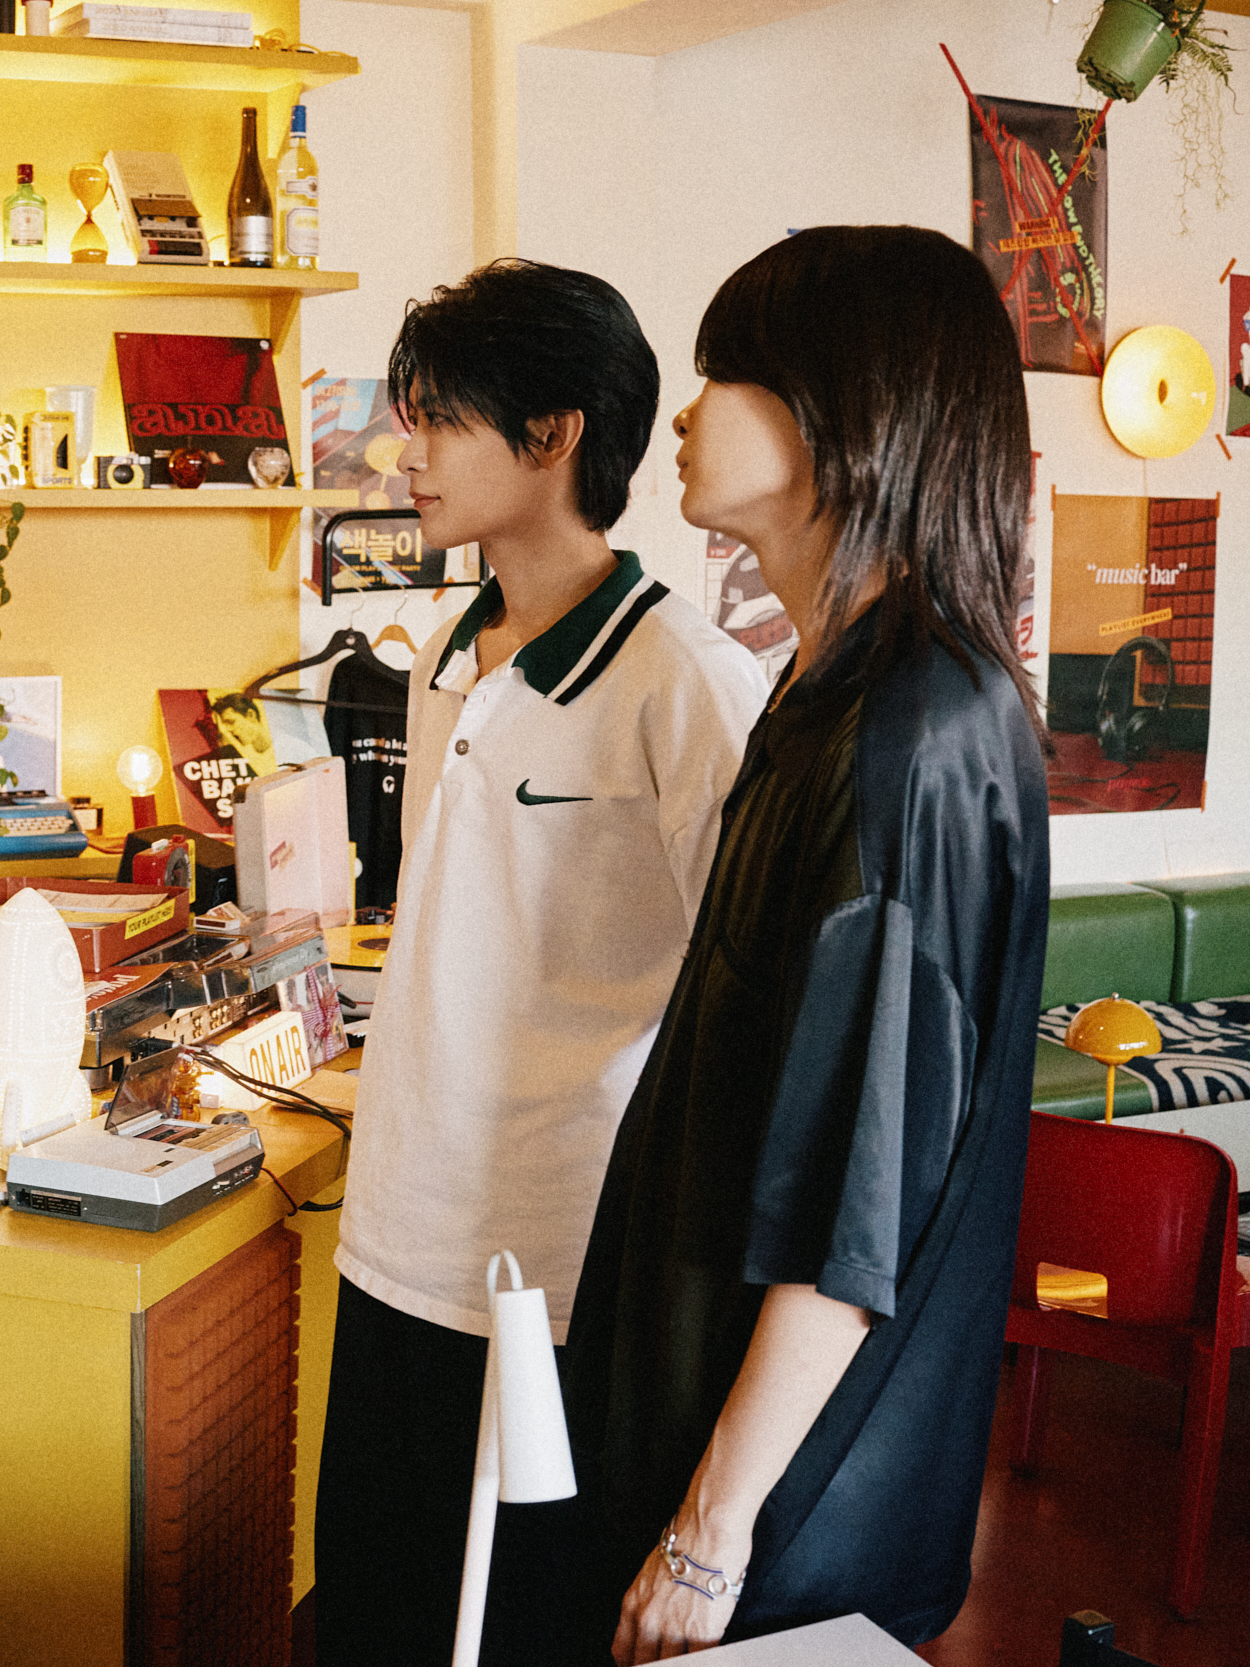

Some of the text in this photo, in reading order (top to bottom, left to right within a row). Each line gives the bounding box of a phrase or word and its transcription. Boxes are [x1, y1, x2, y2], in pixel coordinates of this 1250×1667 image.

[1048, 148, 1068, 186] THE
[1084, 252, 1105, 320] THEORY
[183, 757, 250, 781] CHET
[249, 1024, 307, 1097] ON AIR
